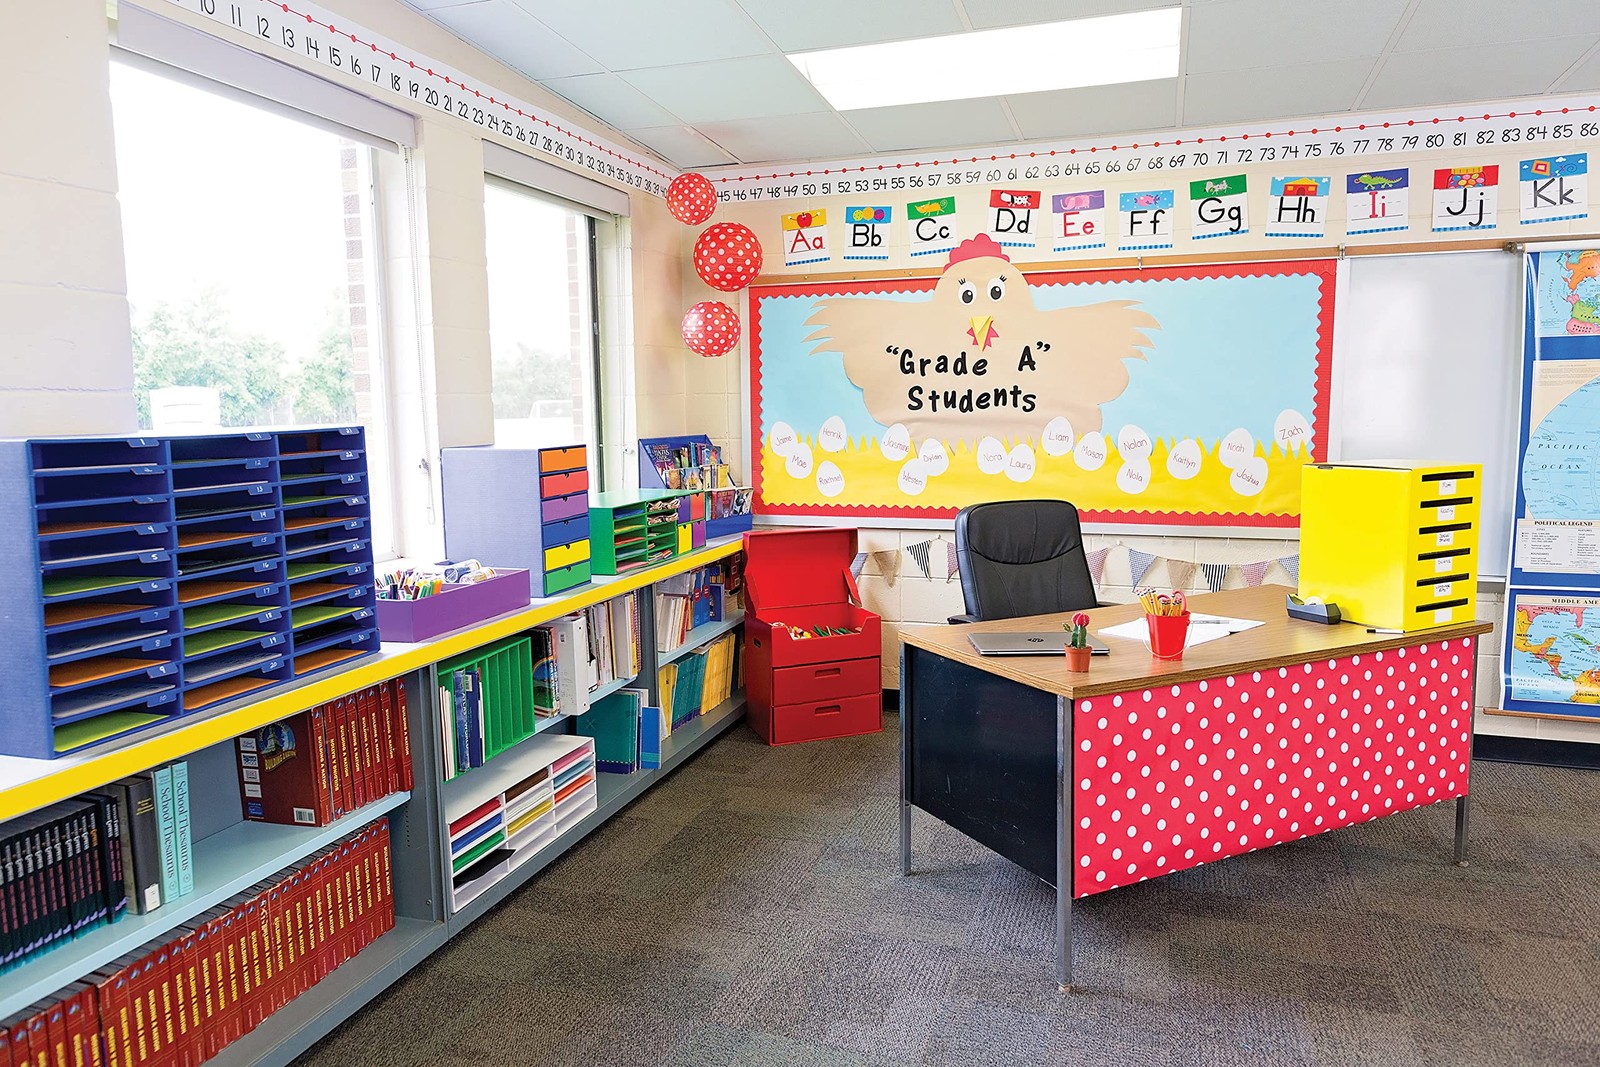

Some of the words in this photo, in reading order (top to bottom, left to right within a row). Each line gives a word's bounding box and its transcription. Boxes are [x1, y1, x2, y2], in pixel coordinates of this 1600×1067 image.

[231, 4, 242, 27] 11
[257, 15, 270, 38] 12
[282, 26, 295, 48] 13
[306, 36, 320, 58] 14
[329, 46, 341, 66] 15
[350, 56, 362, 75] 16
[371, 64, 381, 83] 17
[391, 72, 401, 92] 18
[409, 80, 419, 98] 19
[425, 88, 438, 106] 20
[444, 95, 452, 112] 21
[458, 101, 468, 119] 22
[473, 108, 483, 125] 23
[488, 114, 499, 131] 24
[502, 120, 512, 136] 25
[516, 126, 525, 141] 26
[529, 131, 539, 145] 27
[543, 136, 552, 151] 28
[555, 141, 563, 155] 29
[566, 146, 575, 161] 30
[577, 152, 584, 165] 31
[587, 155, 595, 169] 32
[597, 160, 605, 173] 33
[607, 164, 615, 178] 34
[617, 167, 624, 181] 35
[626, 170, 633, 184] 36
[635, 174, 642, 187] 37
[645, 178, 652, 191] 38
[653, 182, 659, 194] 39
[717, 190, 730, 202] 45
[733, 189, 747, 201] 46
[750, 188, 762, 199] 47
[767, 187, 781, 198] 48
[784, 185, 798, 197] 49
[802, 184, 816, 195] 50
[822, 183, 832, 194] 51
[838, 182, 851, 193] 52
[855, 181, 869, 192] 53
[873, 179, 887, 190] 54
[891, 178, 905, 189] 55
[910, 176, 923, 188] 56
[928, 174, 941, 186] 57
[947, 172, 961, 184] 58
[966, 171, 980, 183] 59
[986, 170, 1001, 181] 60
[1007, 168, 1017, 179] 61
[1025, 167, 1039, 178] 62
[1045, 165, 1059, 177] 63
[1065, 163, 1080, 175] 64
[1085, 162, 1100, 174] 65
[1106, 160, 1120, 172] 66
[1126, 159, 1141, 170] 67
[1148, 157, 1164, 169] 68
[1169, 155, 1185, 167] 69
[1193, 154, 1208, 166] 70
[1217, 152, 1228, 164] 71
[1238, 150, 1252, 162] 72
[1260, 148, 1275, 160] 73
[1282, 146, 1299, 159] 74
[1305, 144, 1321, 157] 75
[1330, 142, 1345, 155] 76
[1353, 140, 1369, 153] 77
[1377, 138, 1394, 151] 78
[1401, 136, 1419, 149] 79
[1426, 134, 1444, 147] 80
[1453, 132, 1466, 146] 81
[1476, 130, 1494, 144] 82
[1502, 128, 1520, 142] 83
[1526, 126, 1547, 140] 84
[1553, 124, 1573, 138] 85
[1580, 123, 1599, 136] 86
[907, 385, 1037, 413] Students
[823, 428, 842, 440] Henrik
[1049, 432, 1069, 442] Liam
[1279, 425, 1303, 440] Zach
[884, 436, 908, 453] Jasmine
[1123, 438, 1147, 450] Nolan
[1228, 442, 1244, 453] Noah
[923, 453, 942, 464] Dylan
[983, 452, 1002, 462] Nora
[1081, 445, 1103, 460] Mason
[792, 455, 807, 468] Mae
[1010, 457, 1031, 470] Laura
[1173, 453, 1196, 468] Kaitlyn
[819, 474, 842, 485] Rachael
[1126, 469, 1142, 482] Nola
[1236, 469, 1260, 486] Joshua
[159, 665, 166, 673] 9
[161, 787, 174, 822] School
[177, 781, 189, 815] School
[164, 822, 177, 879] Thesaurus
[178, 815, 191, 871] Thesaurus
